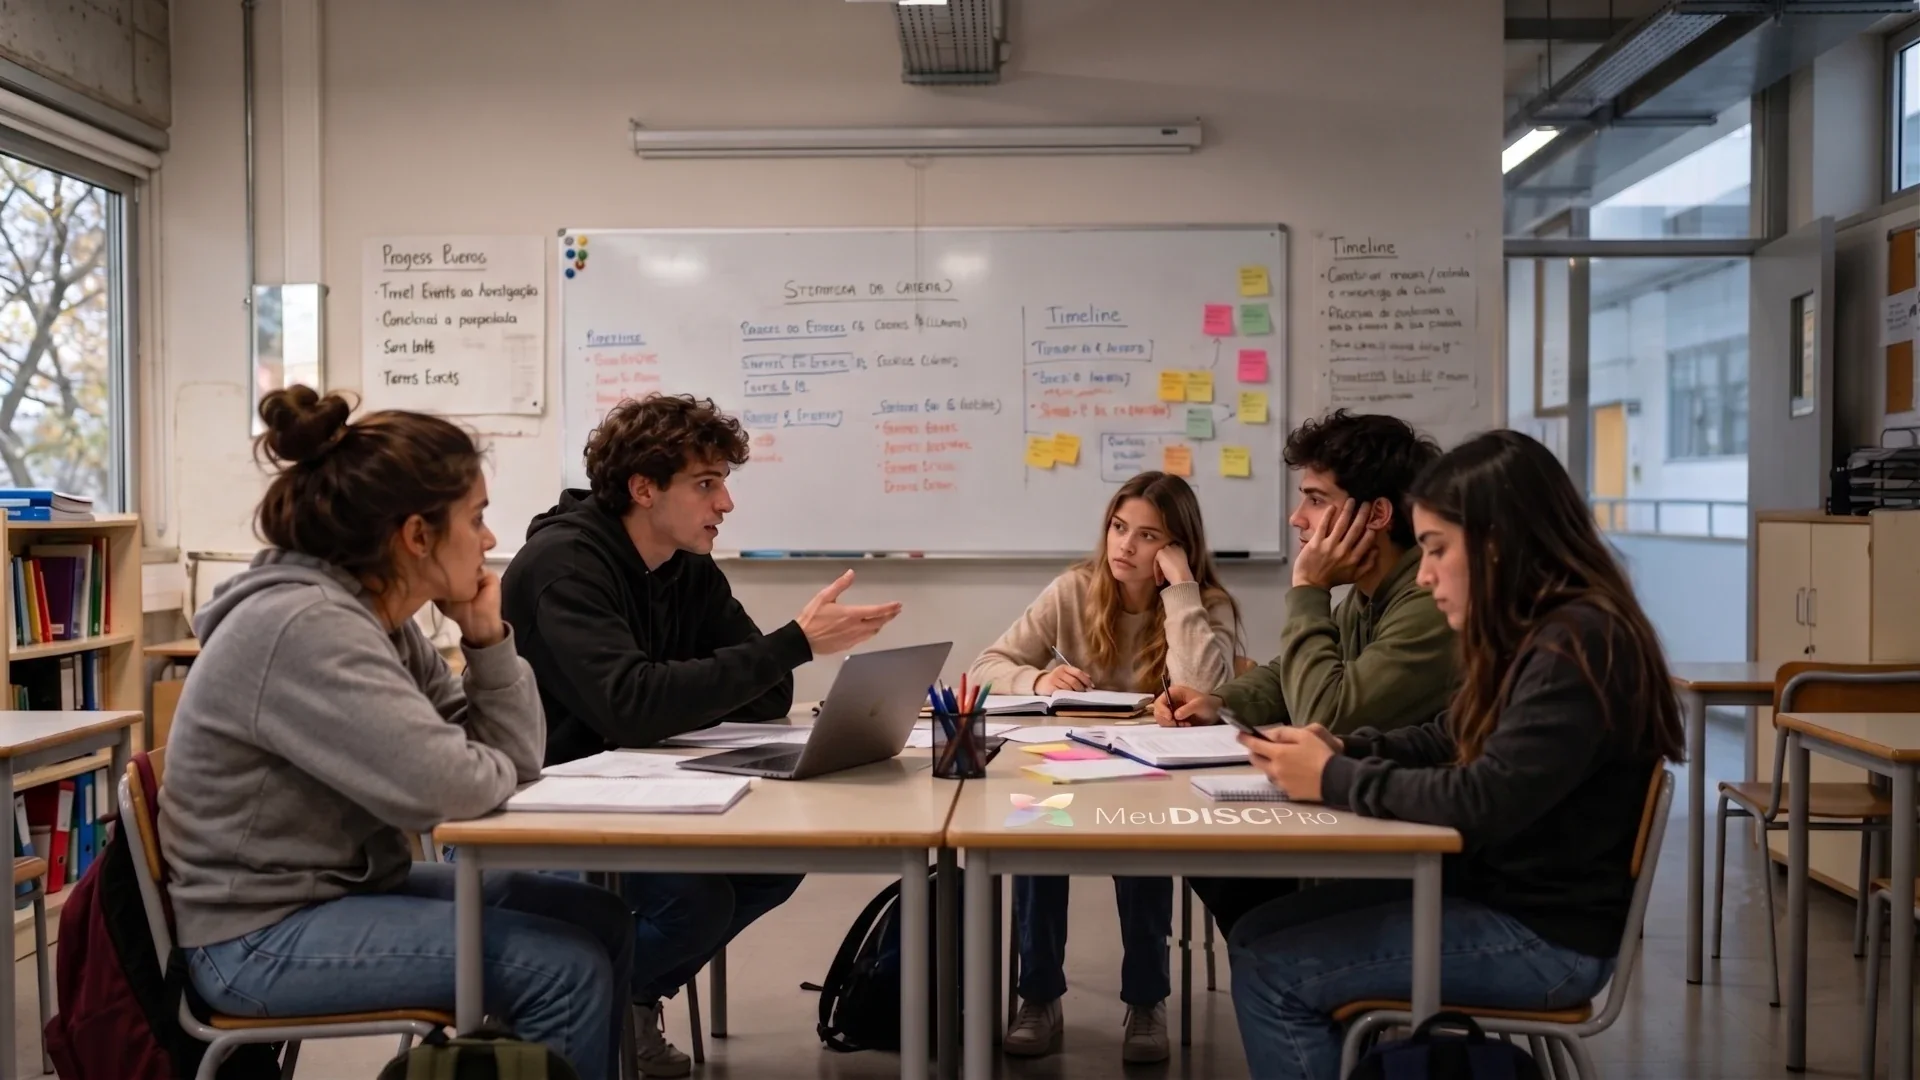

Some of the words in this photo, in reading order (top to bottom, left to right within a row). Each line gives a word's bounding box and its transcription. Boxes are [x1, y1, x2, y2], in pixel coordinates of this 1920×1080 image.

[1329, 236, 1396, 255] Timeline
[383, 244, 432, 271] Progess
[1045, 303, 1122, 324] Timeline
